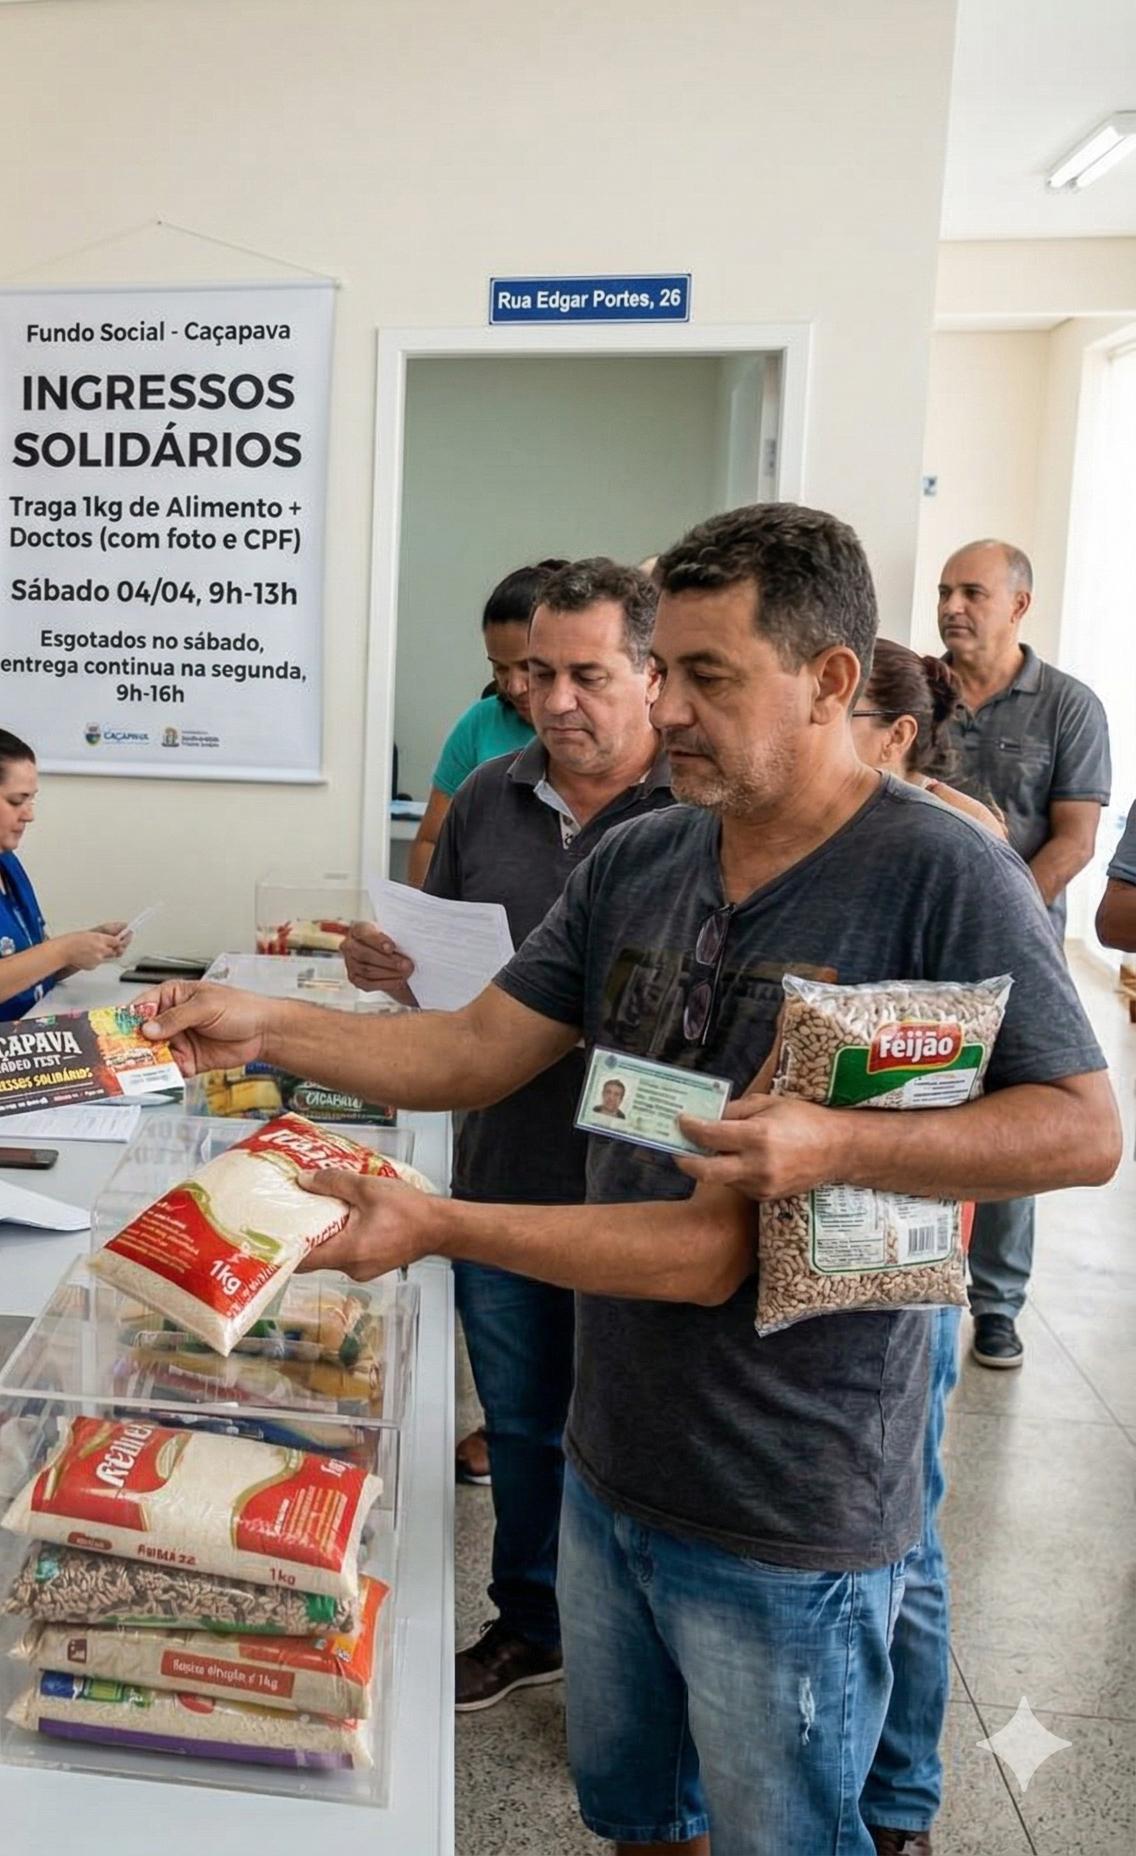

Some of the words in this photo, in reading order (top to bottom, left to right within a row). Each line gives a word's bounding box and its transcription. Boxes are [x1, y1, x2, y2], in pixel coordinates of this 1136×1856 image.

[498, 291, 531, 309] Rua
[537, 290, 588, 312] Edgar
[593, 289, 654, 309] Portes,
[659, 288, 681, 306] 26
[27, 322, 94, 342] Fundo
[100, 321, 165, 341] Social
[184, 322, 291, 346] Caçapava
[23, 373, 295, 411] INGRESSOS
[12, 421, 302, 468] SOLIDÁRIOS
[9, 496, 76, 521] Traga
[82, 495, 123, 522] 1kg
[129, 496, 159, 517] de
[166, 495, 283, 519] Alimento
[9, 526, 93, 548] Doctos
[100, 526, 160, 552] (com
[167, 527, 215, 549] foto
[223, 533, 237, 549] e
[244, 528, 301, 554] CPF)
[11, 577, 110, 602] Sábado
[117, 577, 202, 607] 04/04,
[209, 582, 297, 605] 9h-13h
[40, 629, 146, 652] Esgotados
[152, 636, 178, 650] no
[183, 632, 264, 654] sábado,
[0, 657, 78, 677] entrega
[84, 657, 175, 676] continua
[181, 663, 206, 677] na
[211, 661, 307, 683] segunda,
[116, 684, 184, 703] 9h-16h
[209, 1259, 242, 1295] 1kg
